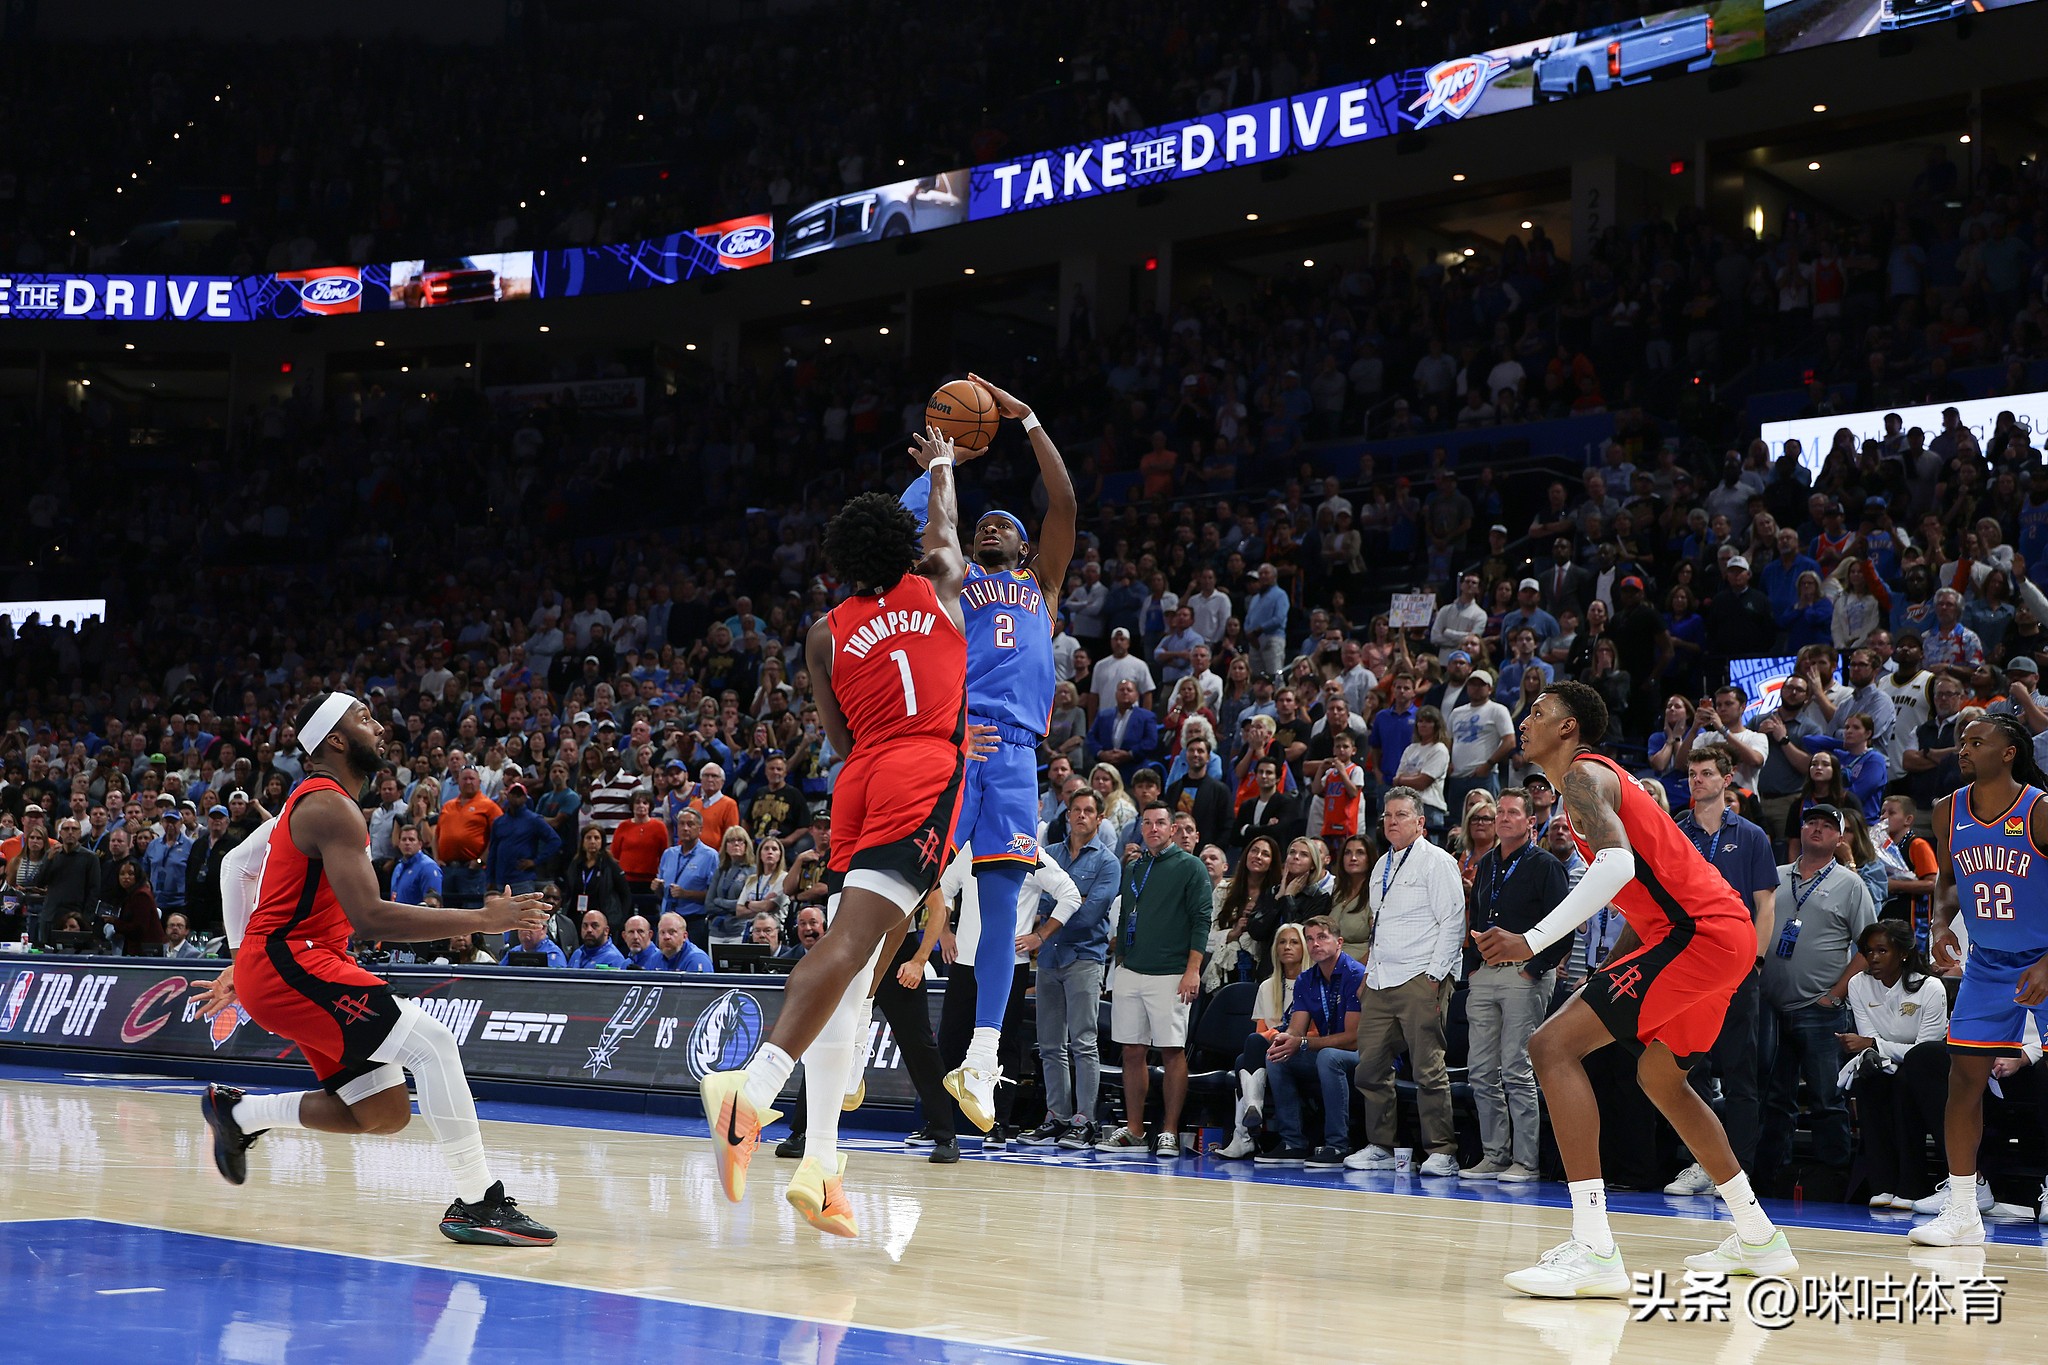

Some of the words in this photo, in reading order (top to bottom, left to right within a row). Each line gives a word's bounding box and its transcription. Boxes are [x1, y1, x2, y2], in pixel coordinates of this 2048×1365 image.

[1427, 62, 1477, 112] OKC
[993, 140, 1127, 210] TAKE
[1131, 137, 1177, 173] THE
[1181, 87, 1368, 172] DRIVE
[16, 284, 60, 309] THE
[63, 279, 233, 317] DRIVE
[960, 579, 1040, 614] THUNDER
[843, 610, 937, 659] THOMPSON
[994, 614, 1016, 649] 2
[889, 649, 917, 717] 1
[1014, 838, 1031, 848] OKC
[1953, 845, 2031, 878] THUNDER
[1974, 882, 2015, 919] 22
[23, 973, 118, 1037] TIP-OFF
[480, 1010, 569, 1045] ESPN
[654, 1017, 678, 1049] VS
